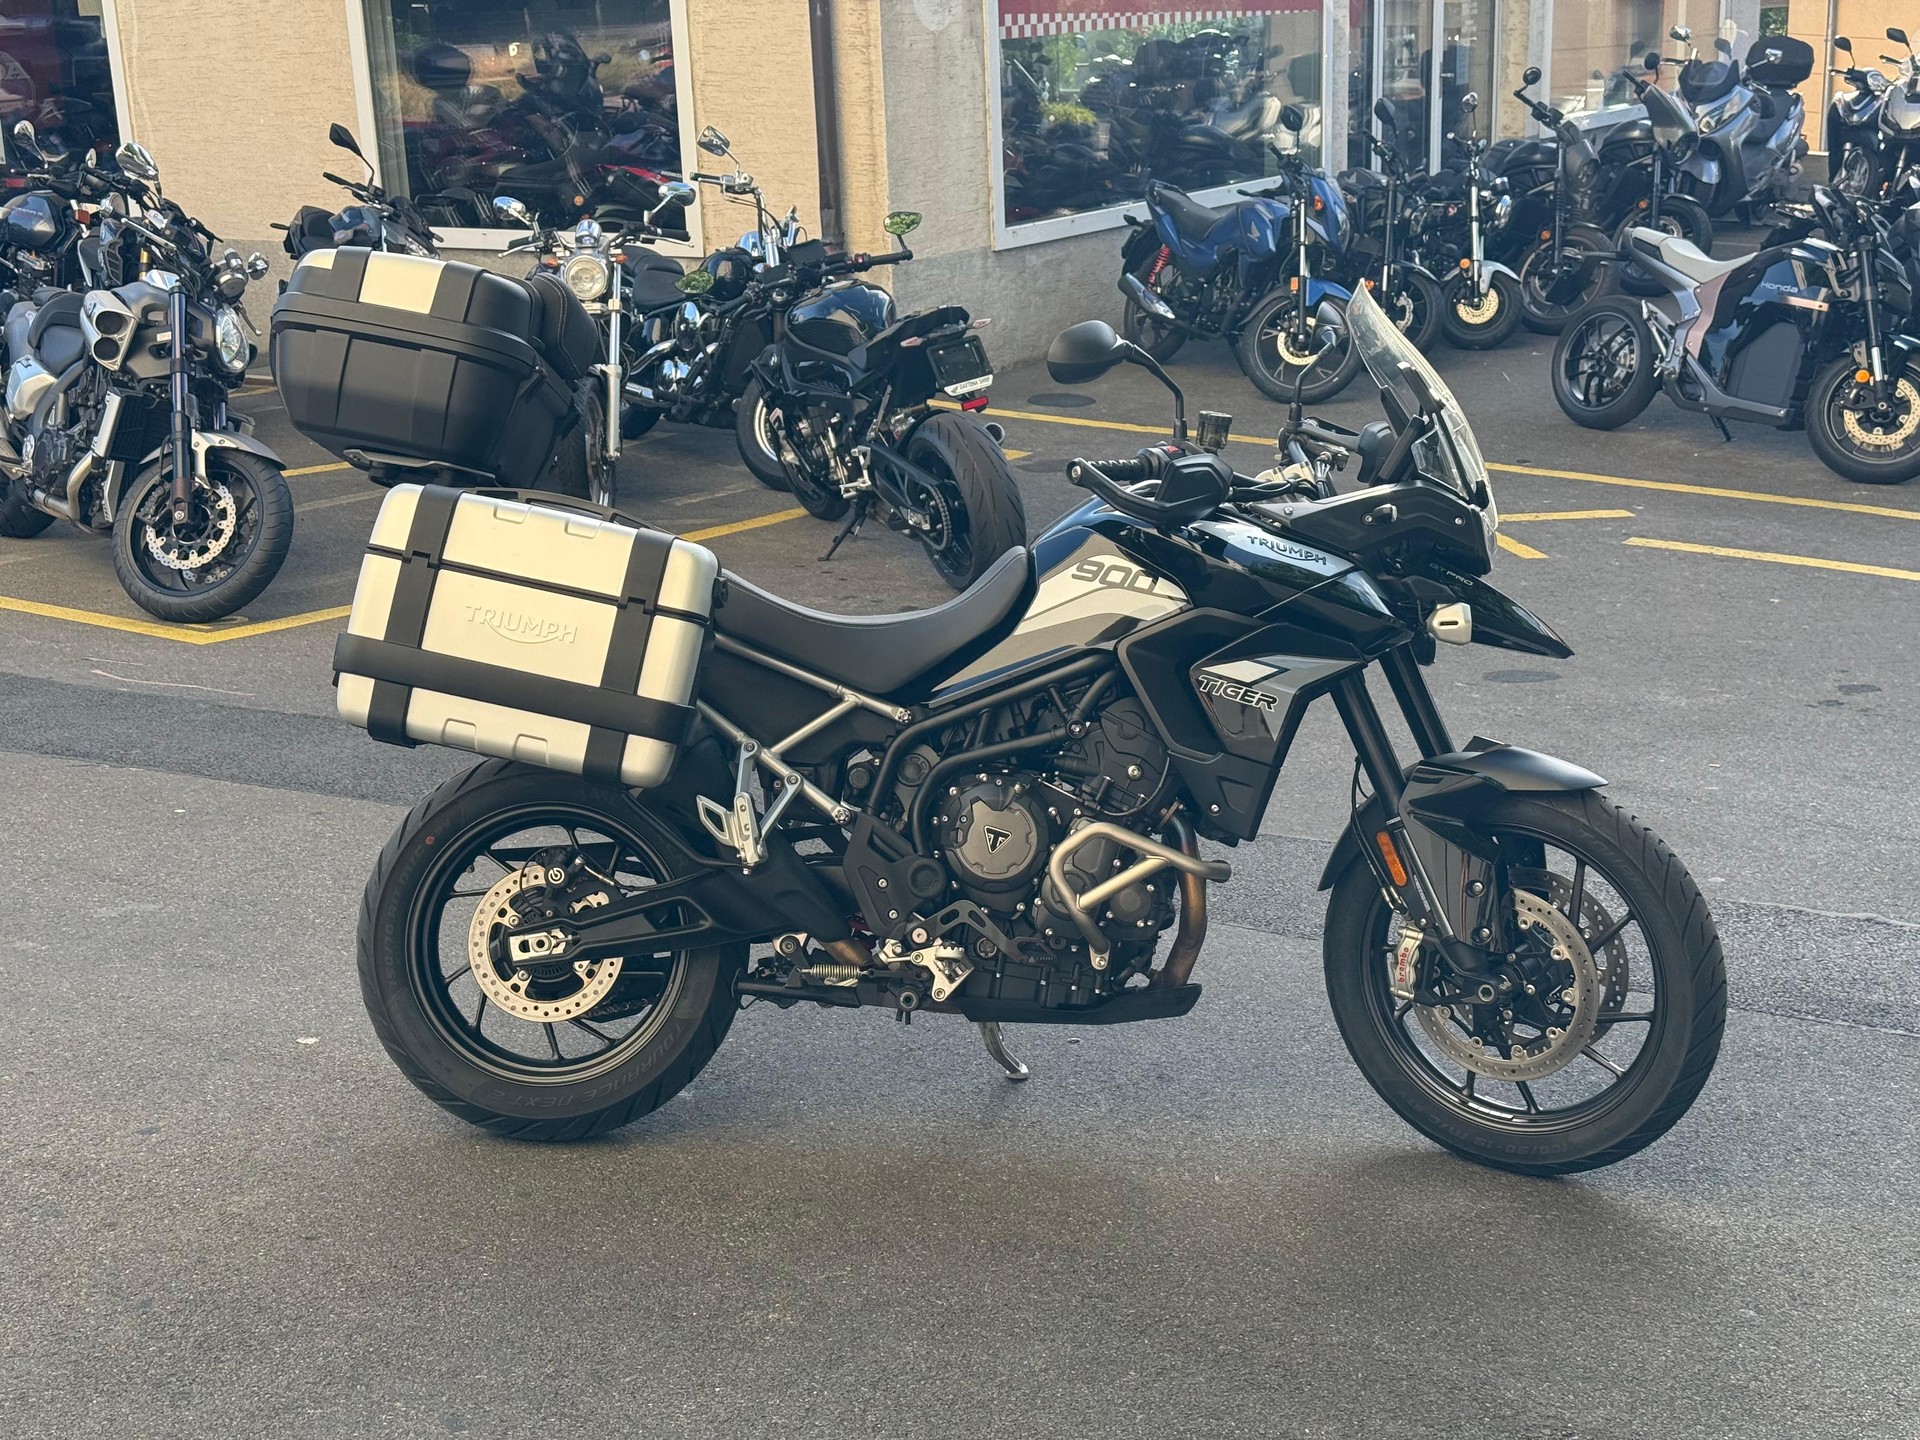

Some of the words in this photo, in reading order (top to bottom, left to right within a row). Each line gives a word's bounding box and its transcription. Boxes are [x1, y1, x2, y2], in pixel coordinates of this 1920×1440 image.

[1760, 282, 1798, 294] Honda
[1247, 535, 1326, 565] TRIUMPH
[1071, 559, 1159, 592] 900
[1446, 570, 1473, 586] PRO
[465, 605, 578, 644] TRIUMPH
[1199, 674, 1279, 712] TIGER
[1397, 947, 1409, 983] brembo
